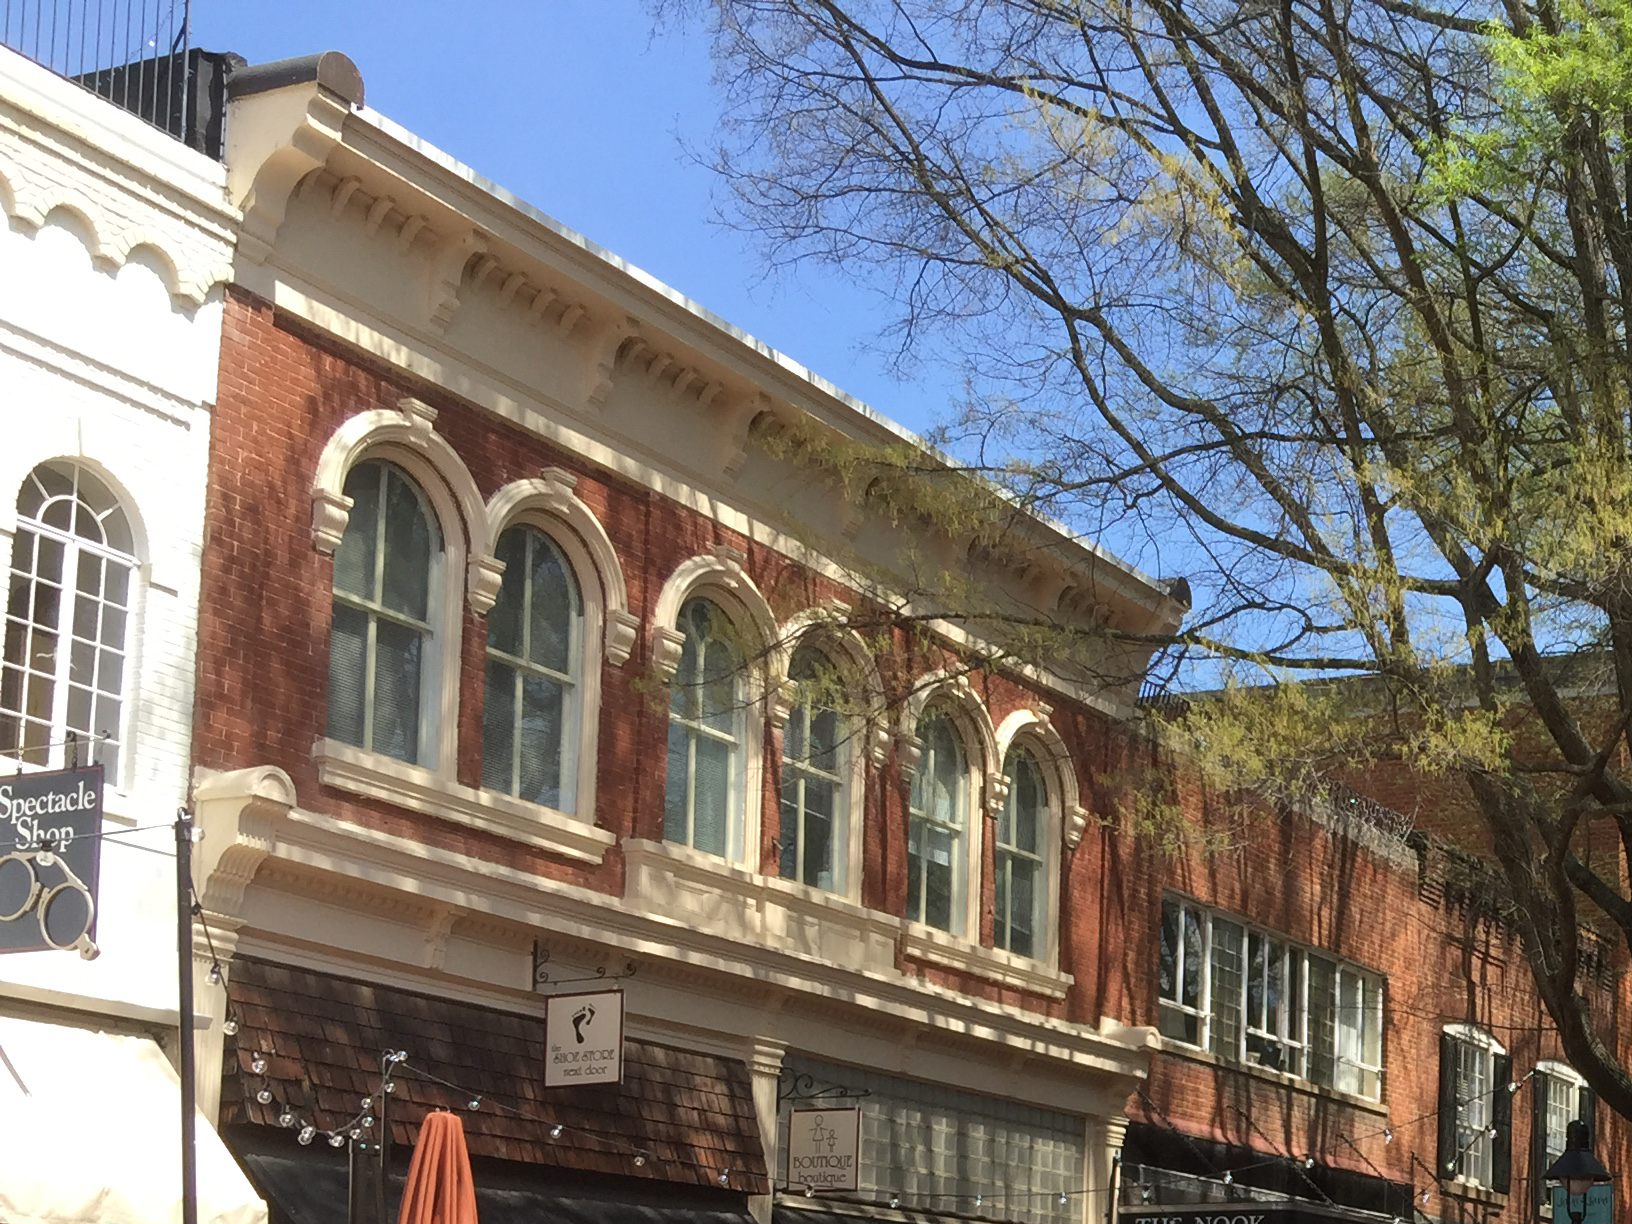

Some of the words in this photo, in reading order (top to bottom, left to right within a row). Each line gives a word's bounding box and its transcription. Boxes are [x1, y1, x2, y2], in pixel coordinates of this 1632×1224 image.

[0, 781, 96, 824] Spectacle
[15, 817, 74, 852] Shop
[553, 1052, 579, 1064] SHOE
[582, 1049, 614, 1062] STORE
[563, 1066, 582, 1076] next
[585, 1064, 607, 1075] door
[793, 1155, 852, 1170] BOUTIQUE
[798, 1171, 846, 1187] boutique
